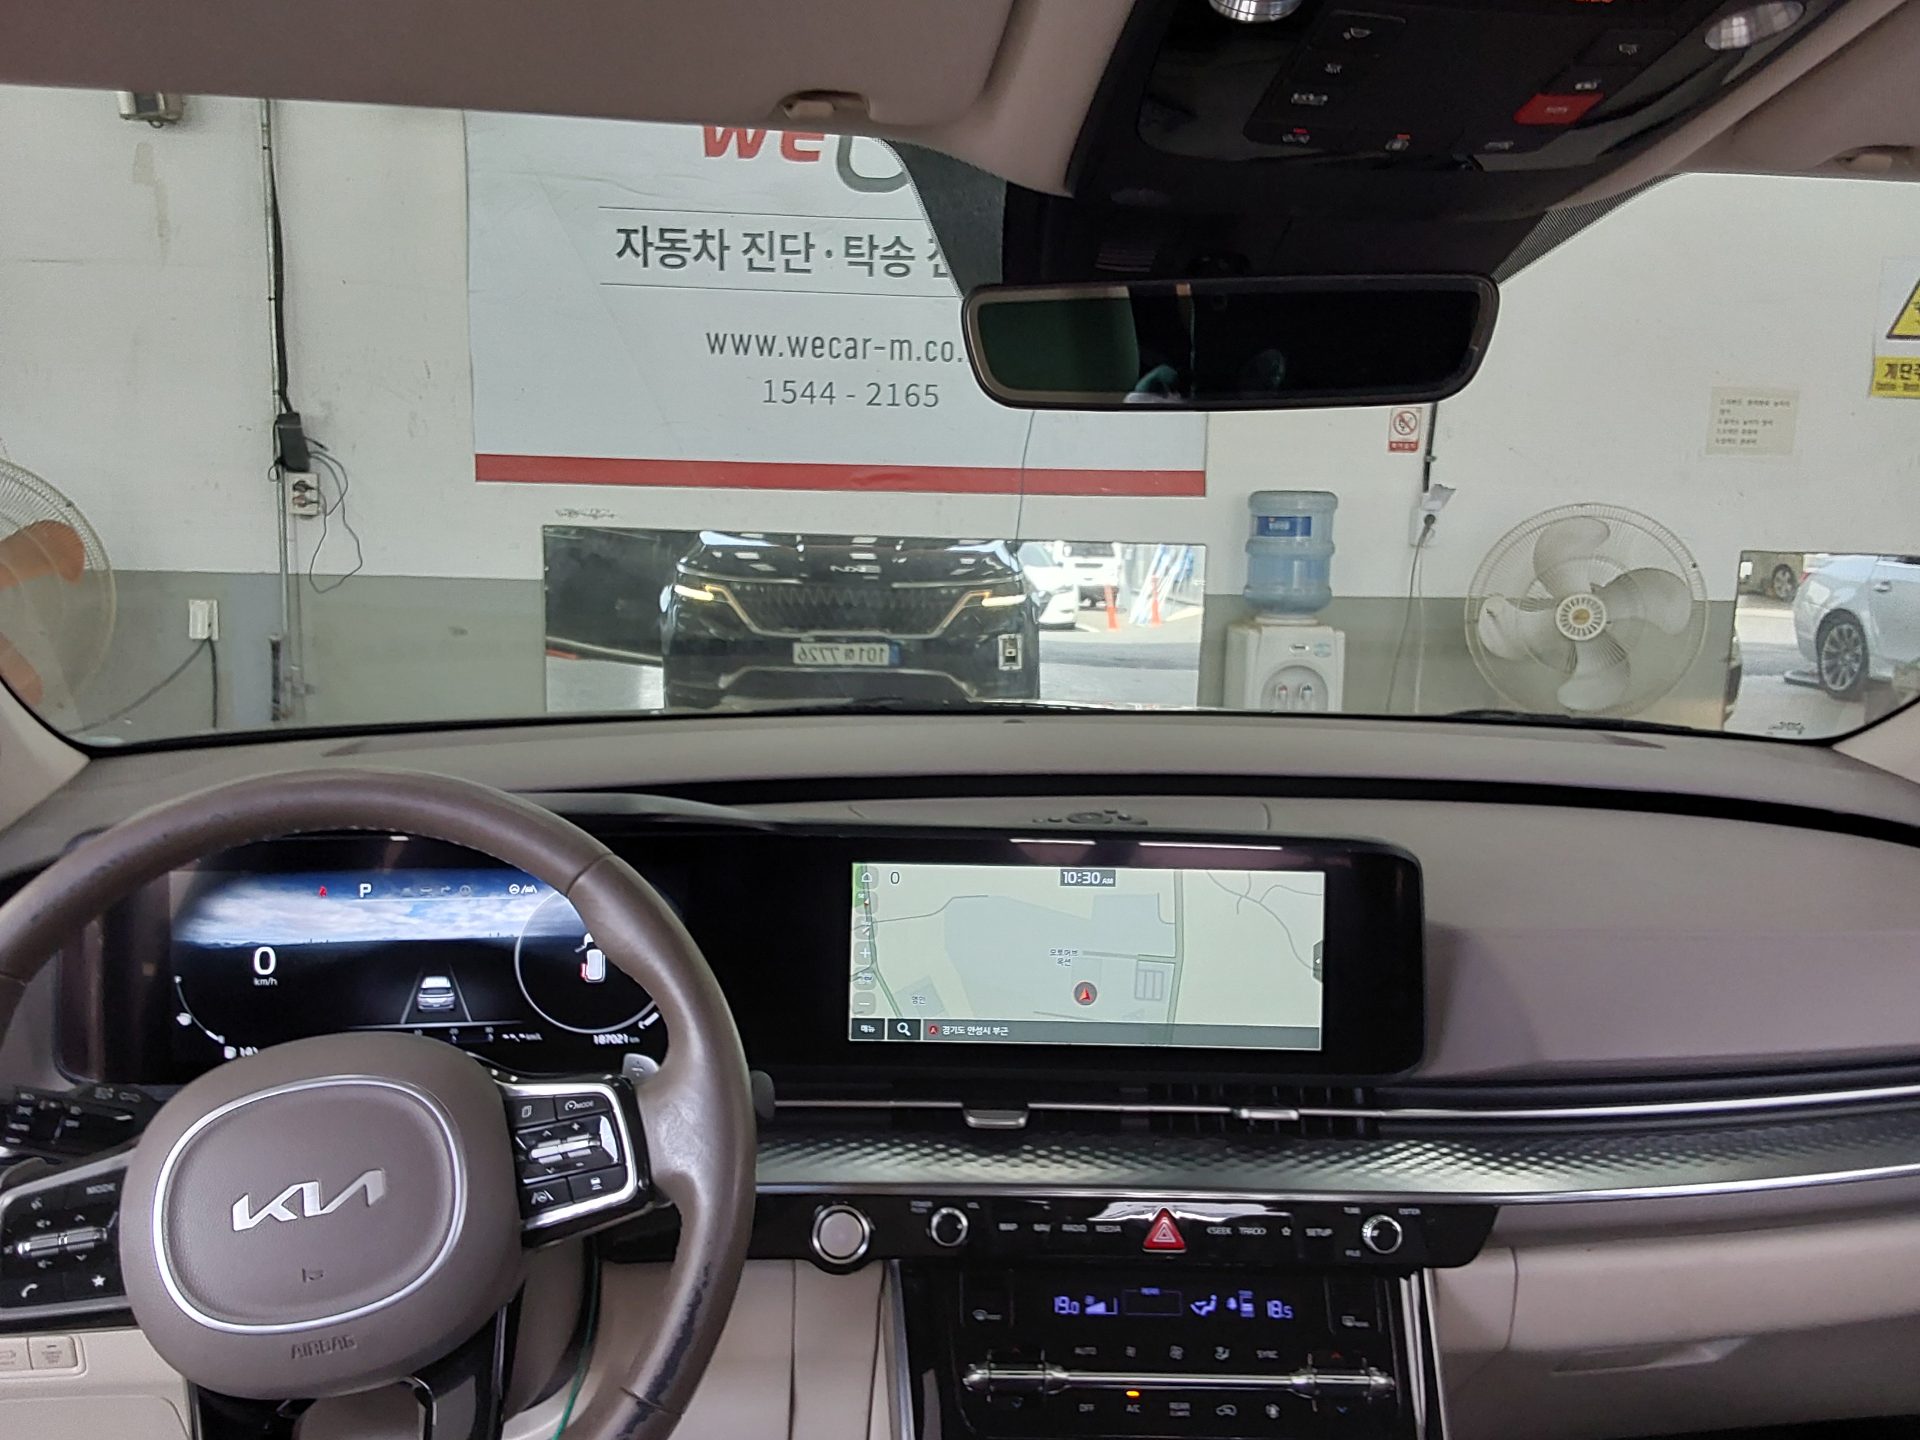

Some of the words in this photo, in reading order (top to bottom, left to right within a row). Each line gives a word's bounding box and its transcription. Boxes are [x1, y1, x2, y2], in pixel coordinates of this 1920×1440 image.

[615, 225, 731, 272] 자동차
[705, 332, 970, 363] www.wecar-m.co.
[762, 378, 836, 405] 1544
[865, 382, 939, 408] 2165
[890, 872, 900, 885] 0
[1062, 871, 1100, 884] 10:30
[359, 883, 371, 898] P
[254, 946, 276, 975] 0
[253, 977, 278, 987] km/h
[942, 1025, 966, 1035] 경기도
[967, 1026, 991, 1036] 안성시
[291, 1335, 357, 1359] AIRBAG
